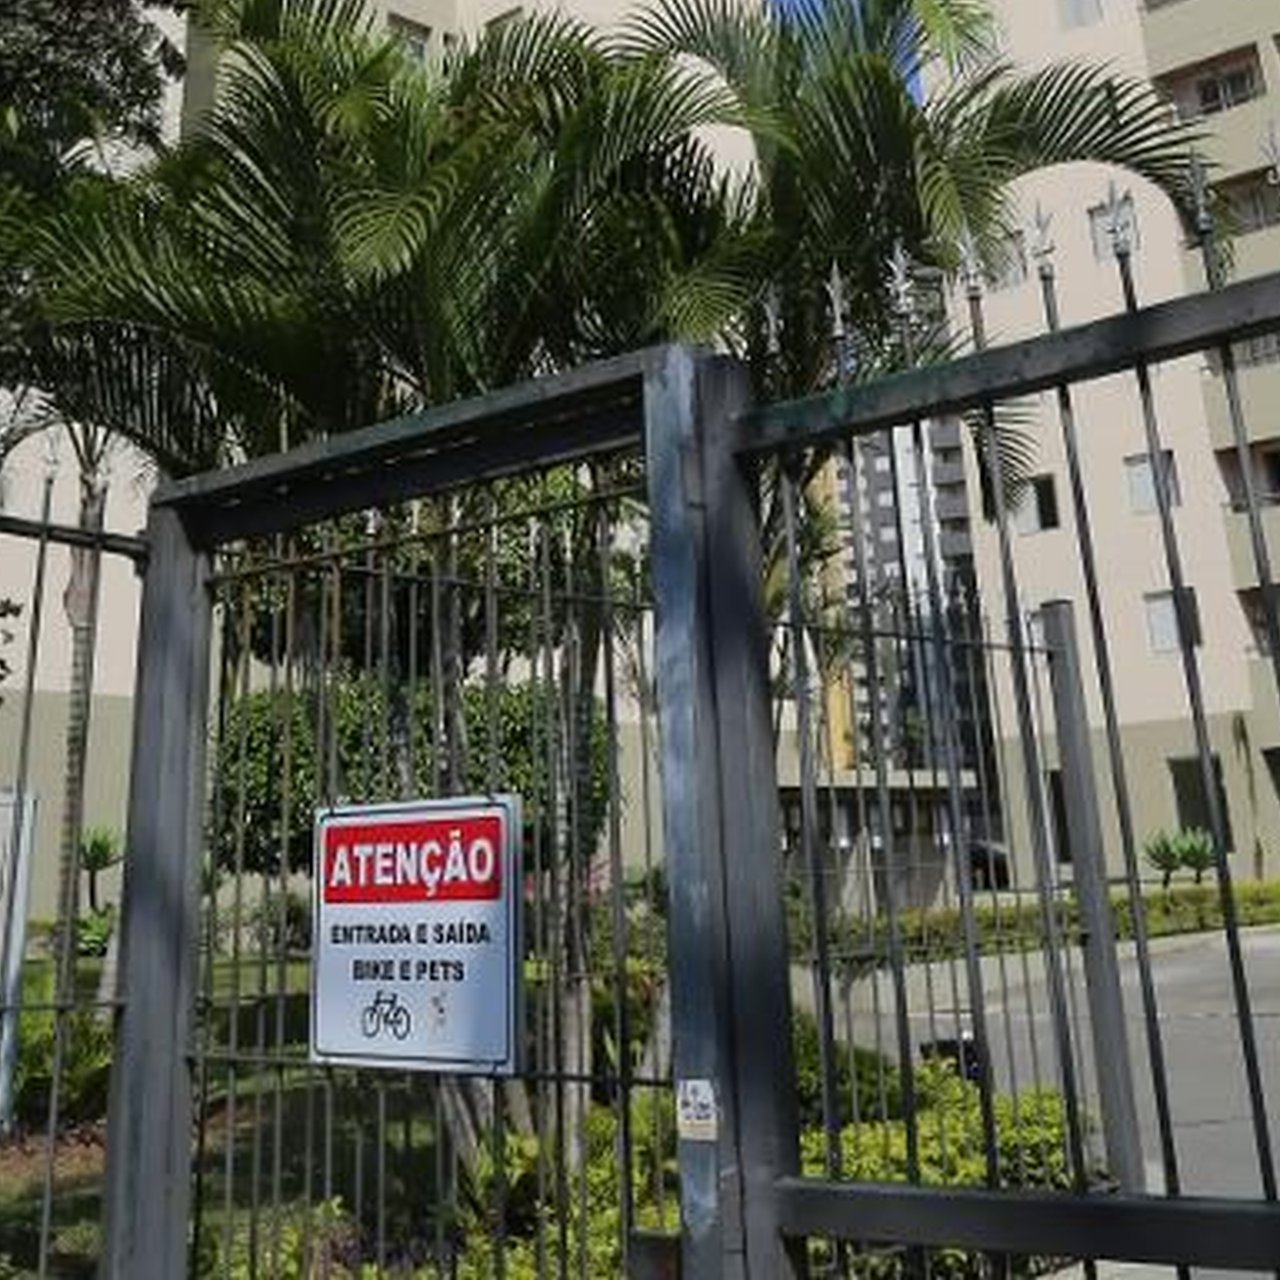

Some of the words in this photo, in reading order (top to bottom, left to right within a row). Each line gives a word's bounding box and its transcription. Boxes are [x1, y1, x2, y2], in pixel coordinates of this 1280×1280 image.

[329, 829, 495, 897] ATENÇÃO
[331, 924, 412, 945] ENTRADA
[416, 924, 429, 945] E
[433, 918, 492, 945] SAÍDA
[353, 959, 396, 982] BIKE
[399, 959, 412, 982] E
[416, 959, 465, 982] PETS
